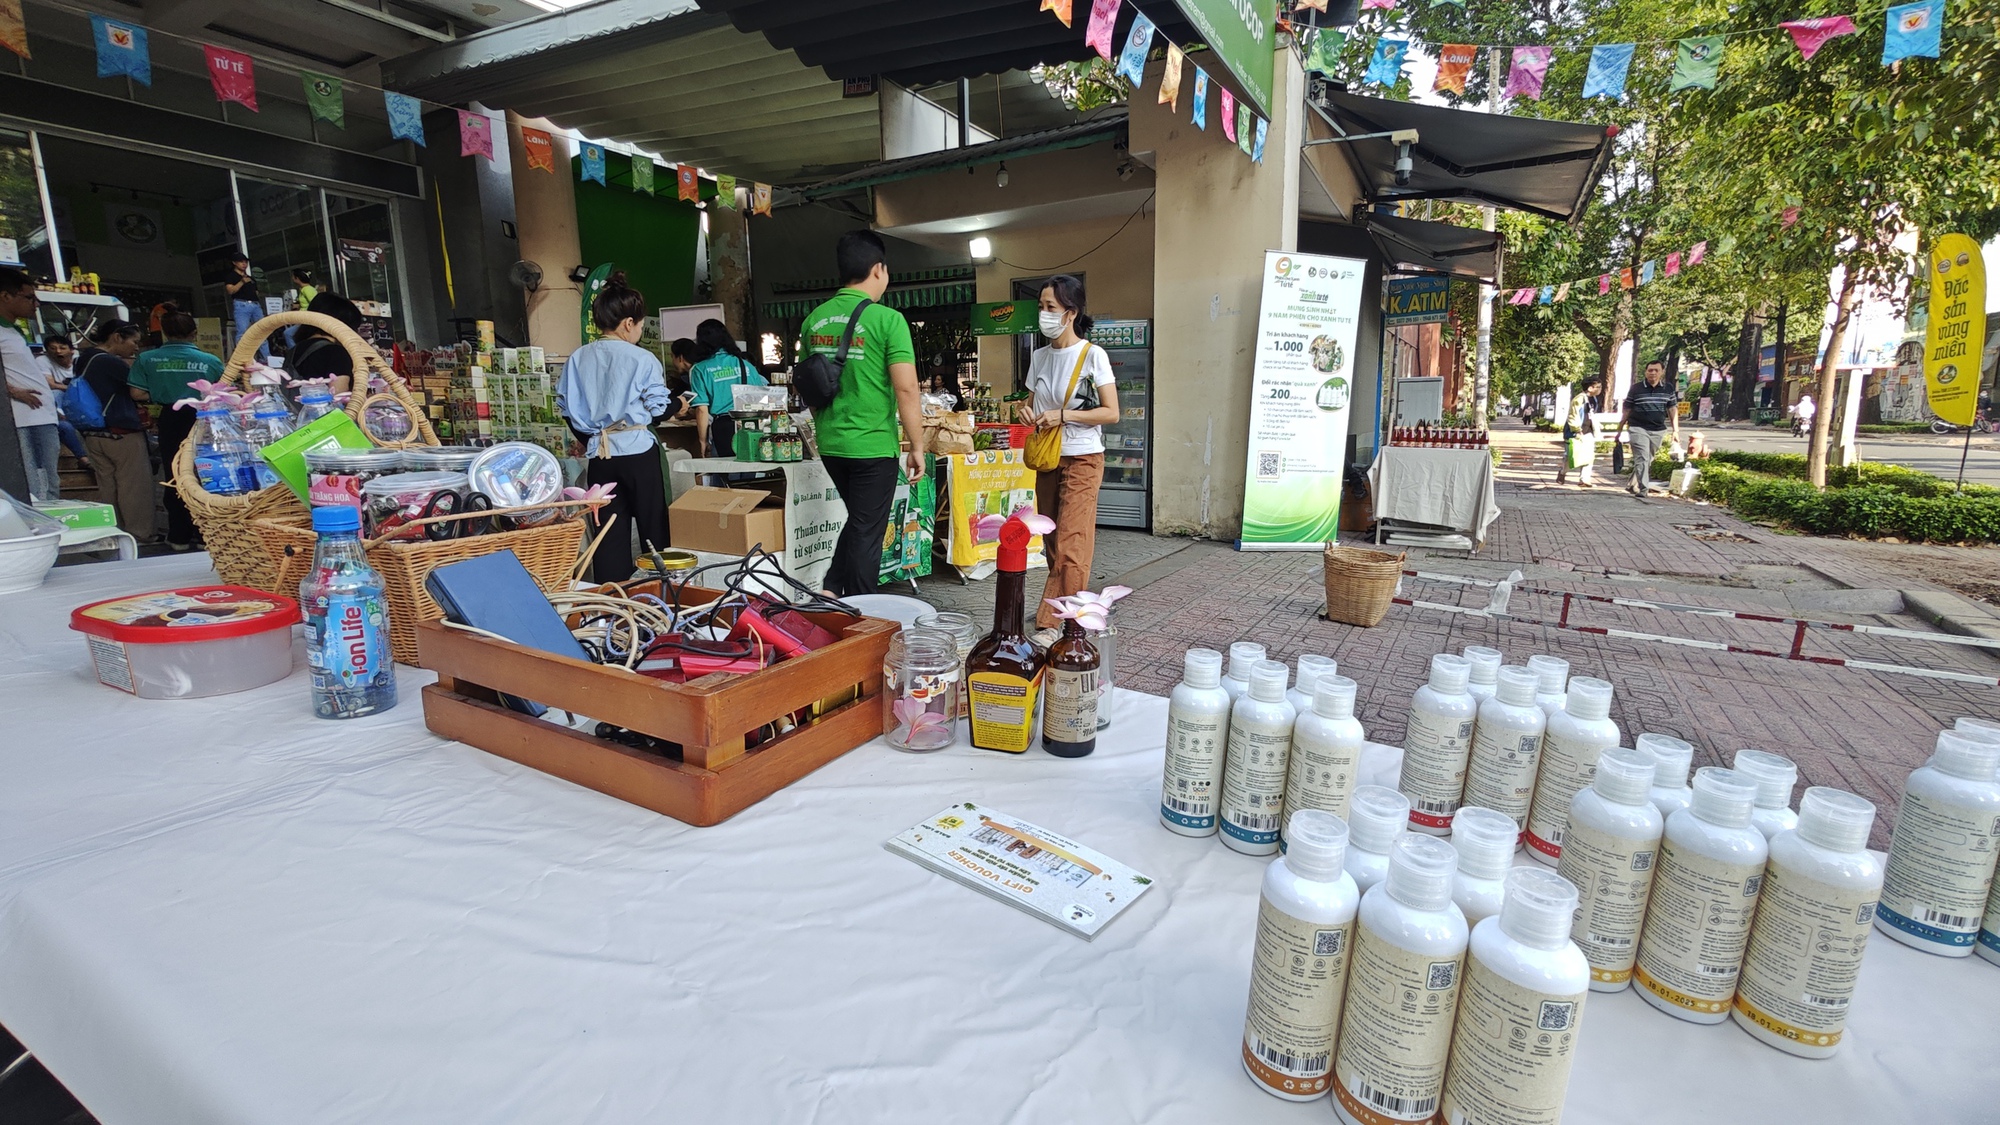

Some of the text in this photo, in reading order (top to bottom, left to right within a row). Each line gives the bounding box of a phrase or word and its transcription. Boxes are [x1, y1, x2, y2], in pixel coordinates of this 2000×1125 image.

[213, 55, 245, 74] TỬ TẾ
[1390, 290, 1447, 315] K.ATM
[1943, 300, 1967, 321] sản
[1938, 320, 1970, 342] vùng
[1274, 340, 1304, 352] 1.000
[1932, 336, 1967, 362] miền
[1269, 388, 1291, 400] 200
[819, 520, 842, 533] chay
[813, 535, 833, 552] sống
[946, 849, 1034, 895] GIFT VOUCHER
[1648, 980, 1695, 1007] 18.01.2025
[1746, 1010, 1800, 1040] 18.01.2025
[1392, 1084, 1440, 1098] 22.01.2025
[1348, 1101, 1377, 1124] nhiên
